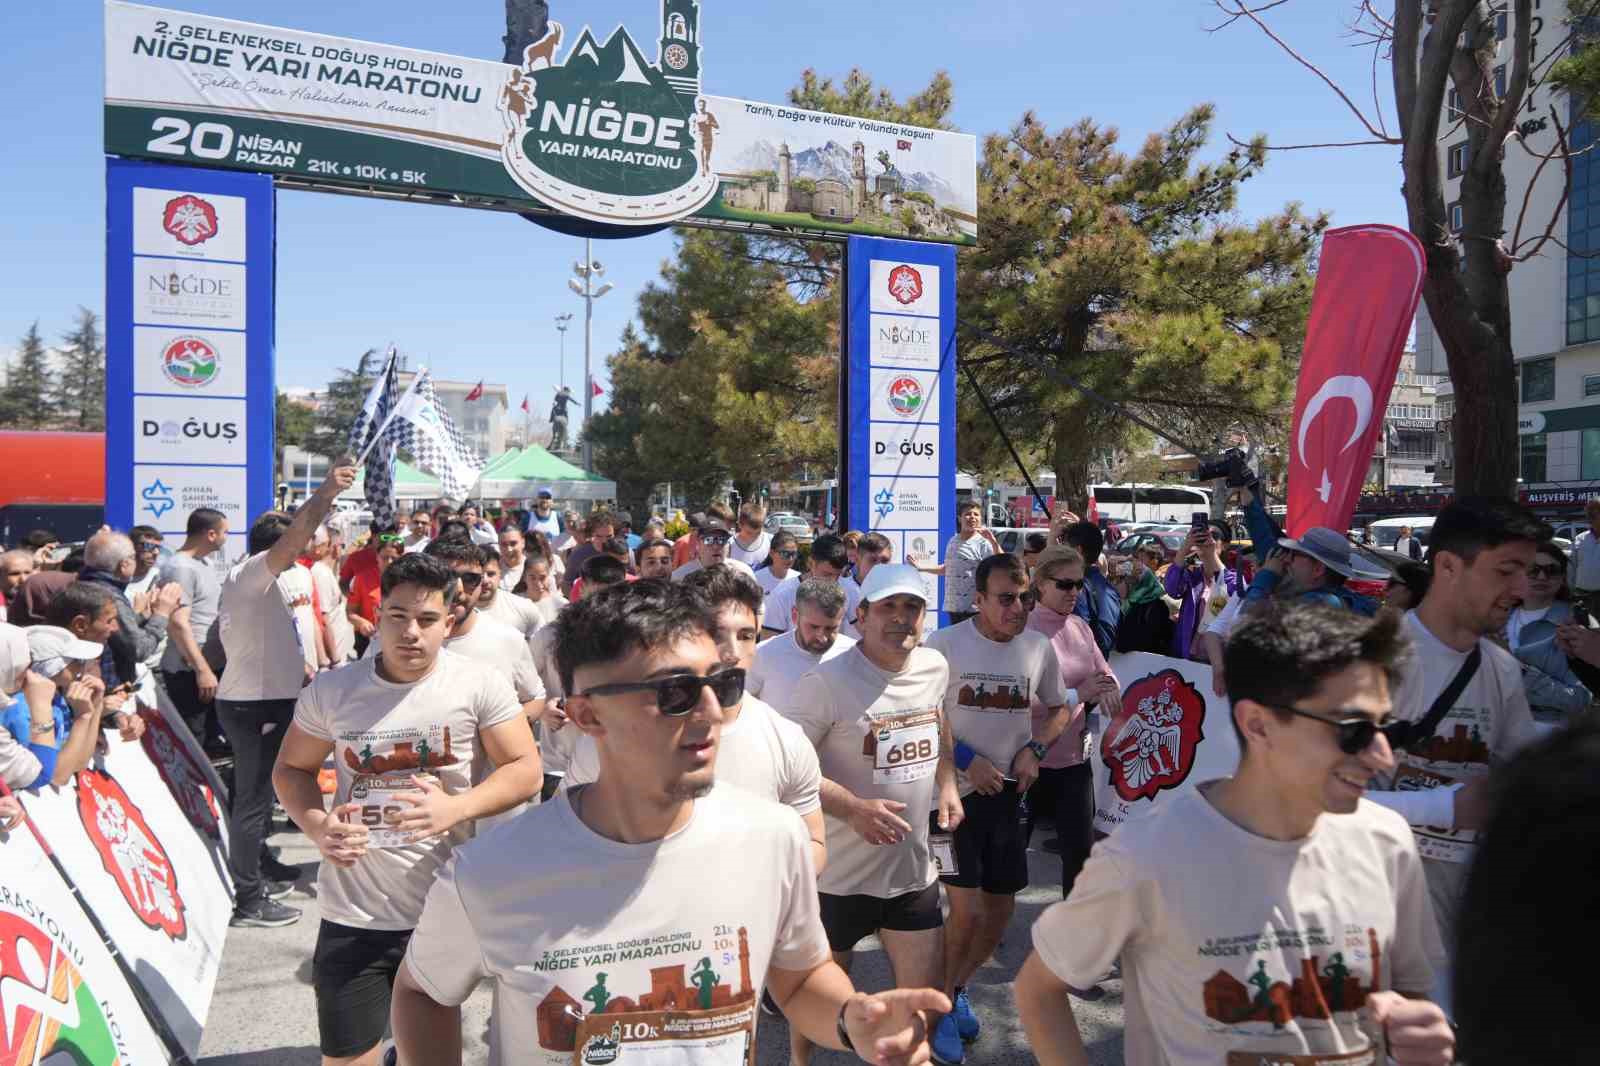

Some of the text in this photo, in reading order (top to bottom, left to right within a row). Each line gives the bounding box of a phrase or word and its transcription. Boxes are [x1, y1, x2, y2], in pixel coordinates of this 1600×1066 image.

[154, 20, 464, 80] 2. GELENEKSEL DOĞUŞ HOLDİNG
[132, 34, 482, 104] NİĞDE YARI MARATONU
[540, 98, 685, 151] NİĞDE
[745, 103, 775, 120] Tarih,
[808, 115, 822, 124] ve
[823, 114, 856, 129] Kültür
[858, 120, 899, 135] Yolunda
[146, 116, 234, 160] 20
[236, 132, 303, 155] NİSAN
[235, 150, 427, 184] PAZAR 21K 10K 5K
[538, 140, 682, 170] YARI MARATONU
[182, 503, 240, 511] FOUNDATION
[886, 740, 932, 764] 688
[533, 956, 579, 972] NİĞDE
[583, 952, 616, 967] YARI
[619, 940, 702, 962] MARATONU
